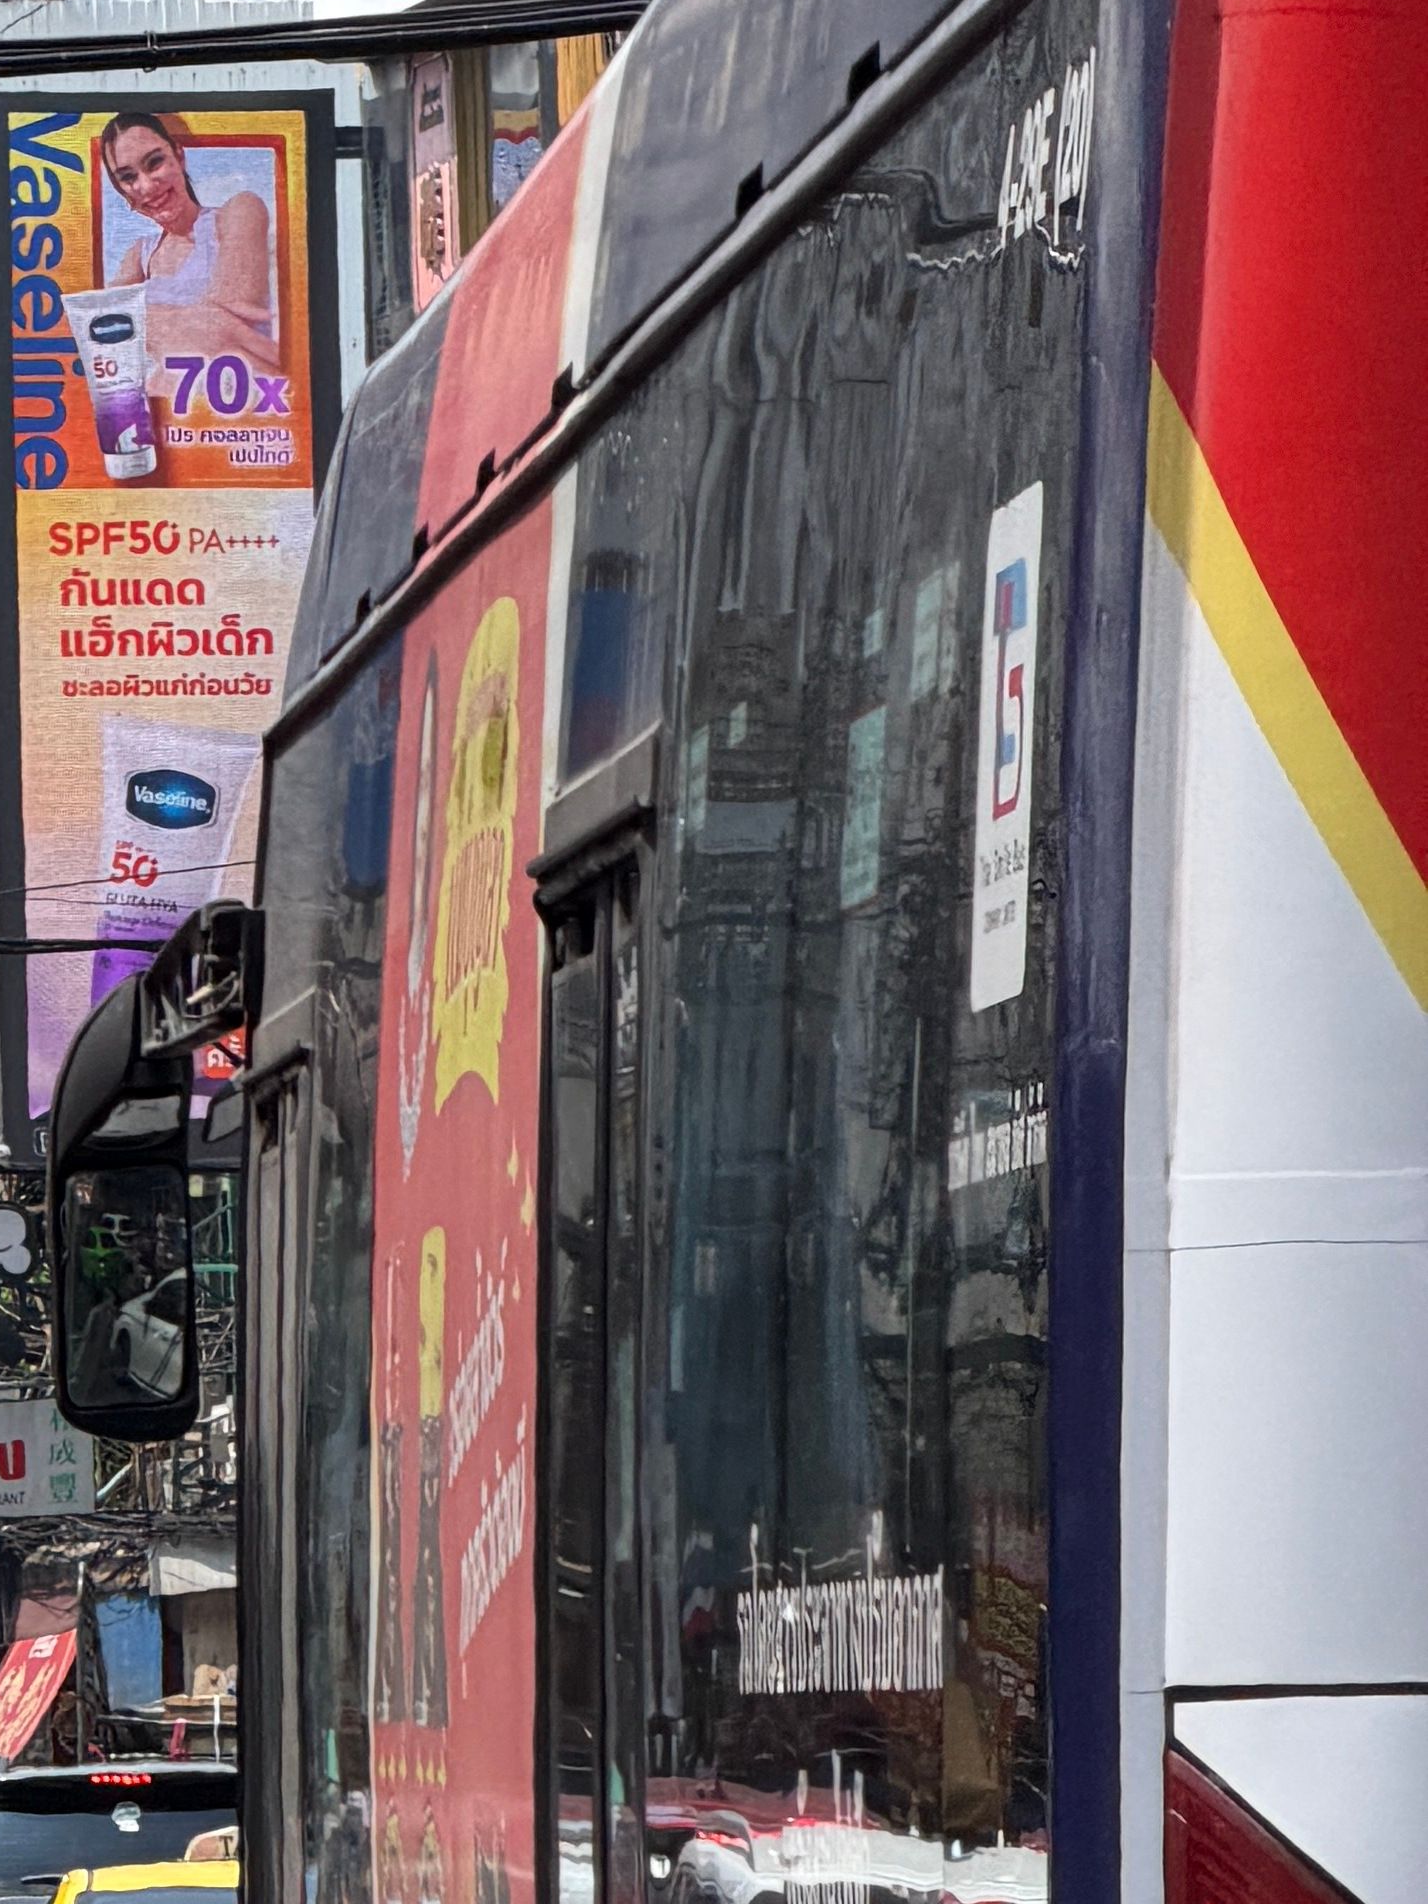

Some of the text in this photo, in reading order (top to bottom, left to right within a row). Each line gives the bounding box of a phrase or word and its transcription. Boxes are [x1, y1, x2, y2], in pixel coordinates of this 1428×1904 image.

[9, 113, 83, 489] Vaseline
[165, 355, 291, 415] 70x
[60, 568, 205, 607] กันแดด
[60, 613, 275, 659] แฮ็กผิวเด็ก
[62, 672, 273, 698] ชะลอผิวแก่ก่อนวัย
[134, 785, 209, 811] Vaseline
